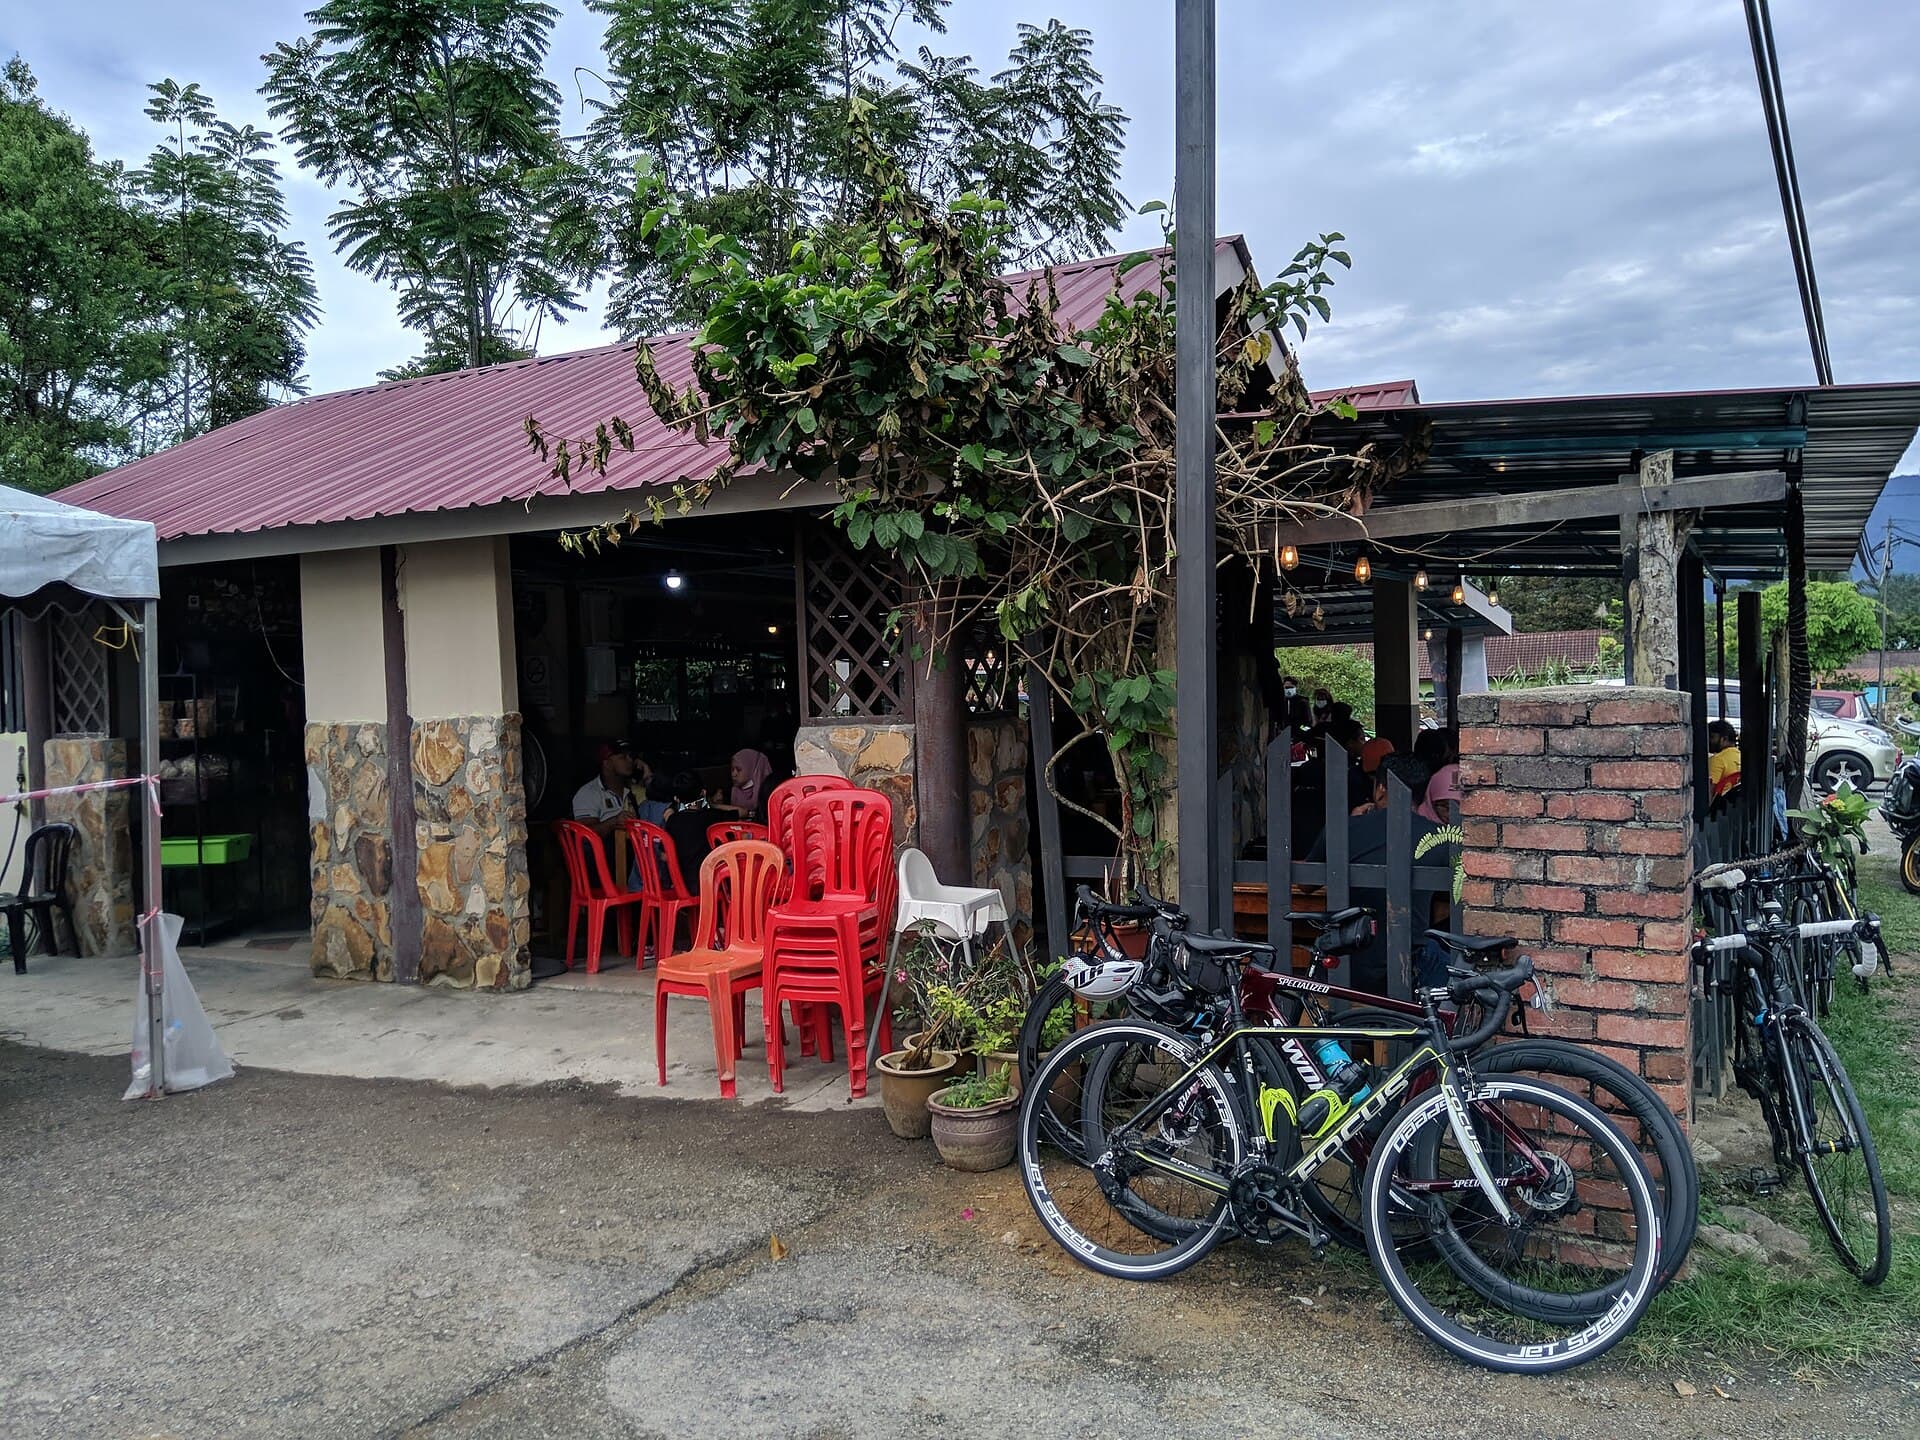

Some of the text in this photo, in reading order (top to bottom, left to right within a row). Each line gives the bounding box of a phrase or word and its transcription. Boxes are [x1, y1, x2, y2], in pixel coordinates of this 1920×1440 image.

[1277, 977, 1329, 994] SPECIALIZED
[1298, 1073, 1409, 1181] FOCUS
[1445, 1084, 1483, 1154] FOCUS
[1042, 1201, 1098, 1255] SPEED
[1507, 1342, 1560, 1358] JET
[1567, 1290, 1634, 1350] SPEED
